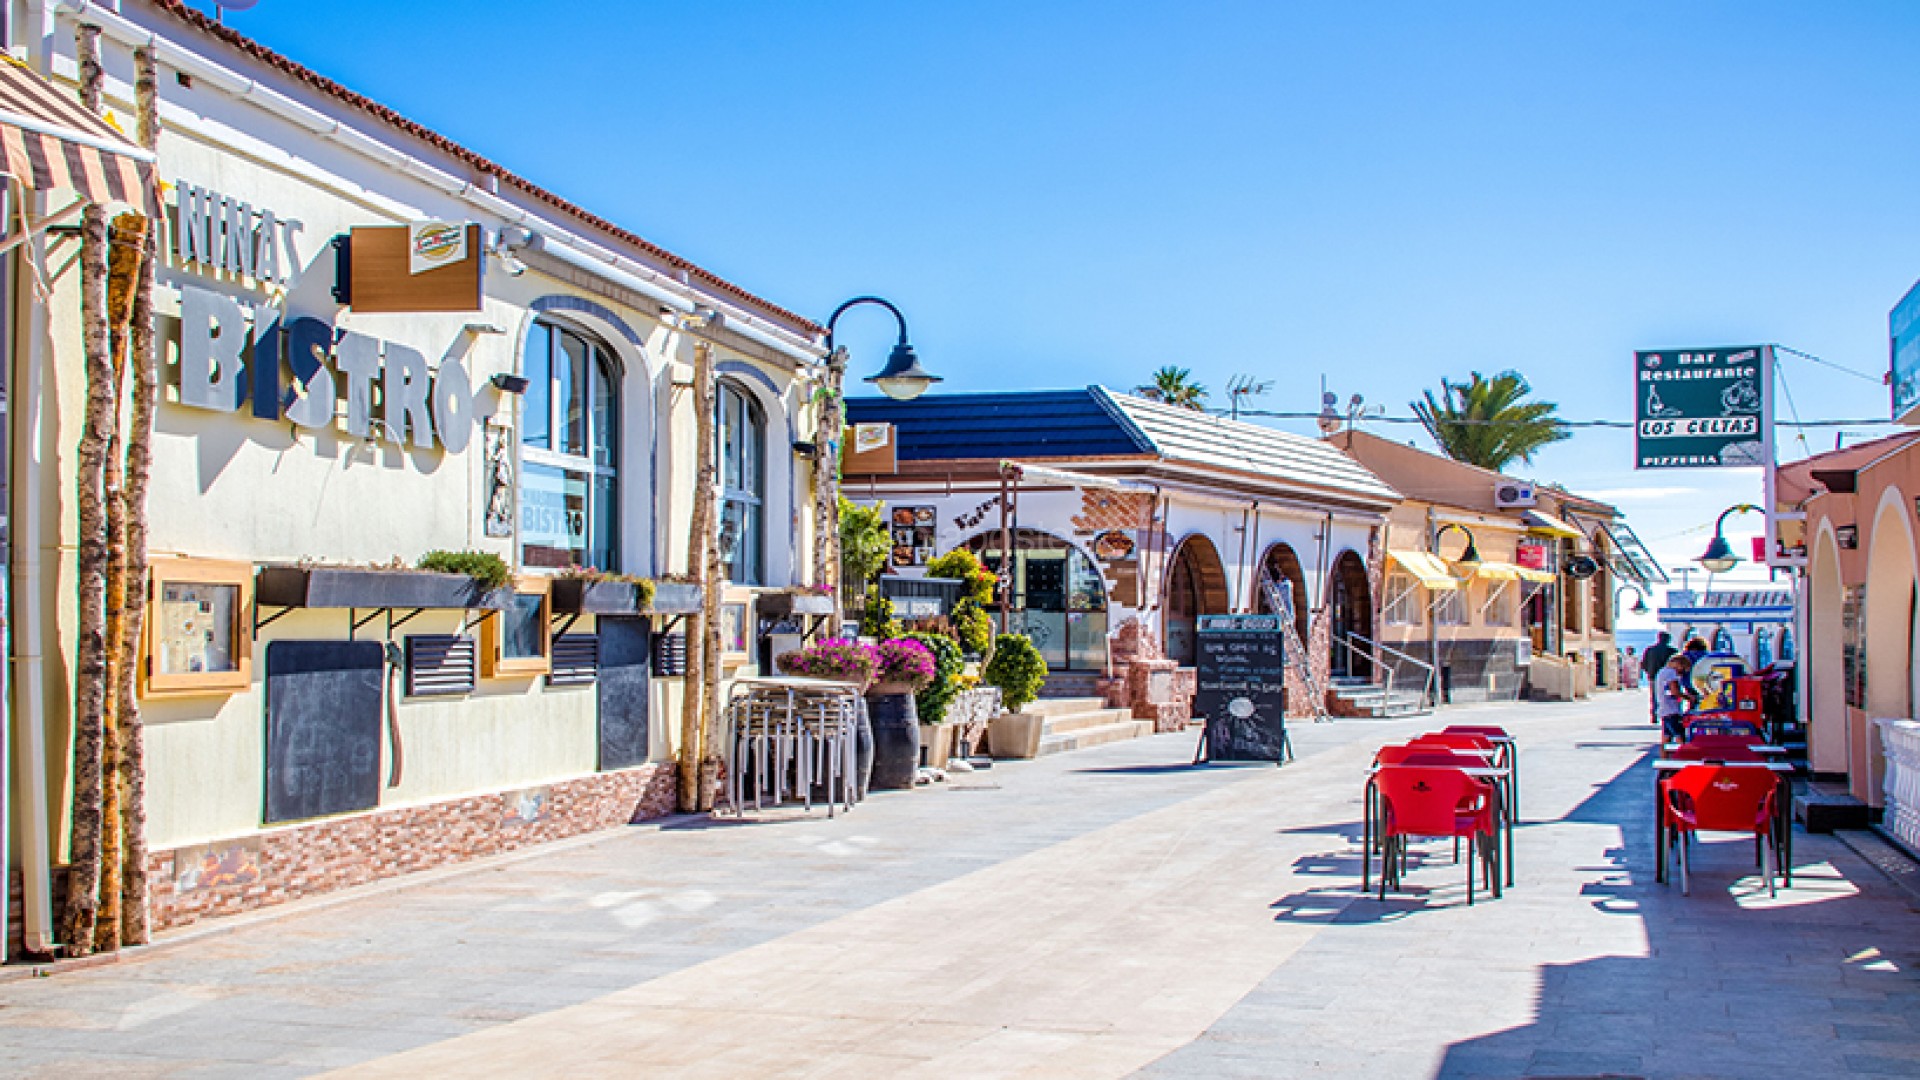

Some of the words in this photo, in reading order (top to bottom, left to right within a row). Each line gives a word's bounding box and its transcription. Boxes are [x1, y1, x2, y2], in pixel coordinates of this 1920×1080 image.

[176, 178, 303, 289] NINAS
[1678, 352, 1717, 365] Bar
[181, 284, 473, 455] BISTRO
[1640, 366, 1756, 381] Restaurante
[1642, 421, 1676, 436] LOS
[1686, 418, 1756, 434] CELTAS
